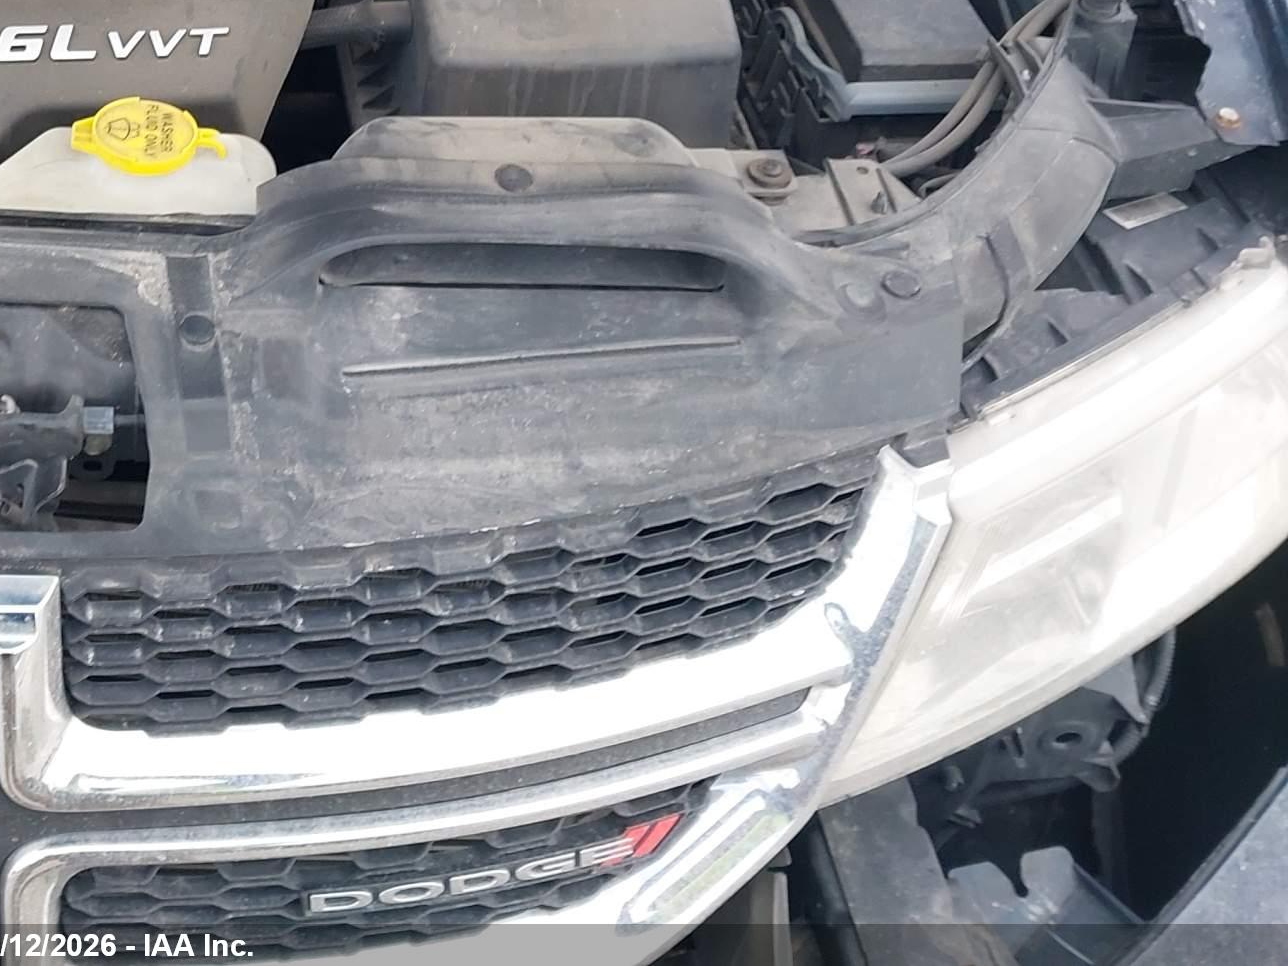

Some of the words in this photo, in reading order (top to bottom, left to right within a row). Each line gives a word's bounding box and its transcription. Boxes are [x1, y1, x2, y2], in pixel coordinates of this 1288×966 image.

[107, 26, 230, 59] VVT
[145, 104, 160, 131] FLUID
[161, 112, 175, 153] WASHER
[144, 133, 159, 157] ONLY
[308, 837, 635, 913] DODGE
